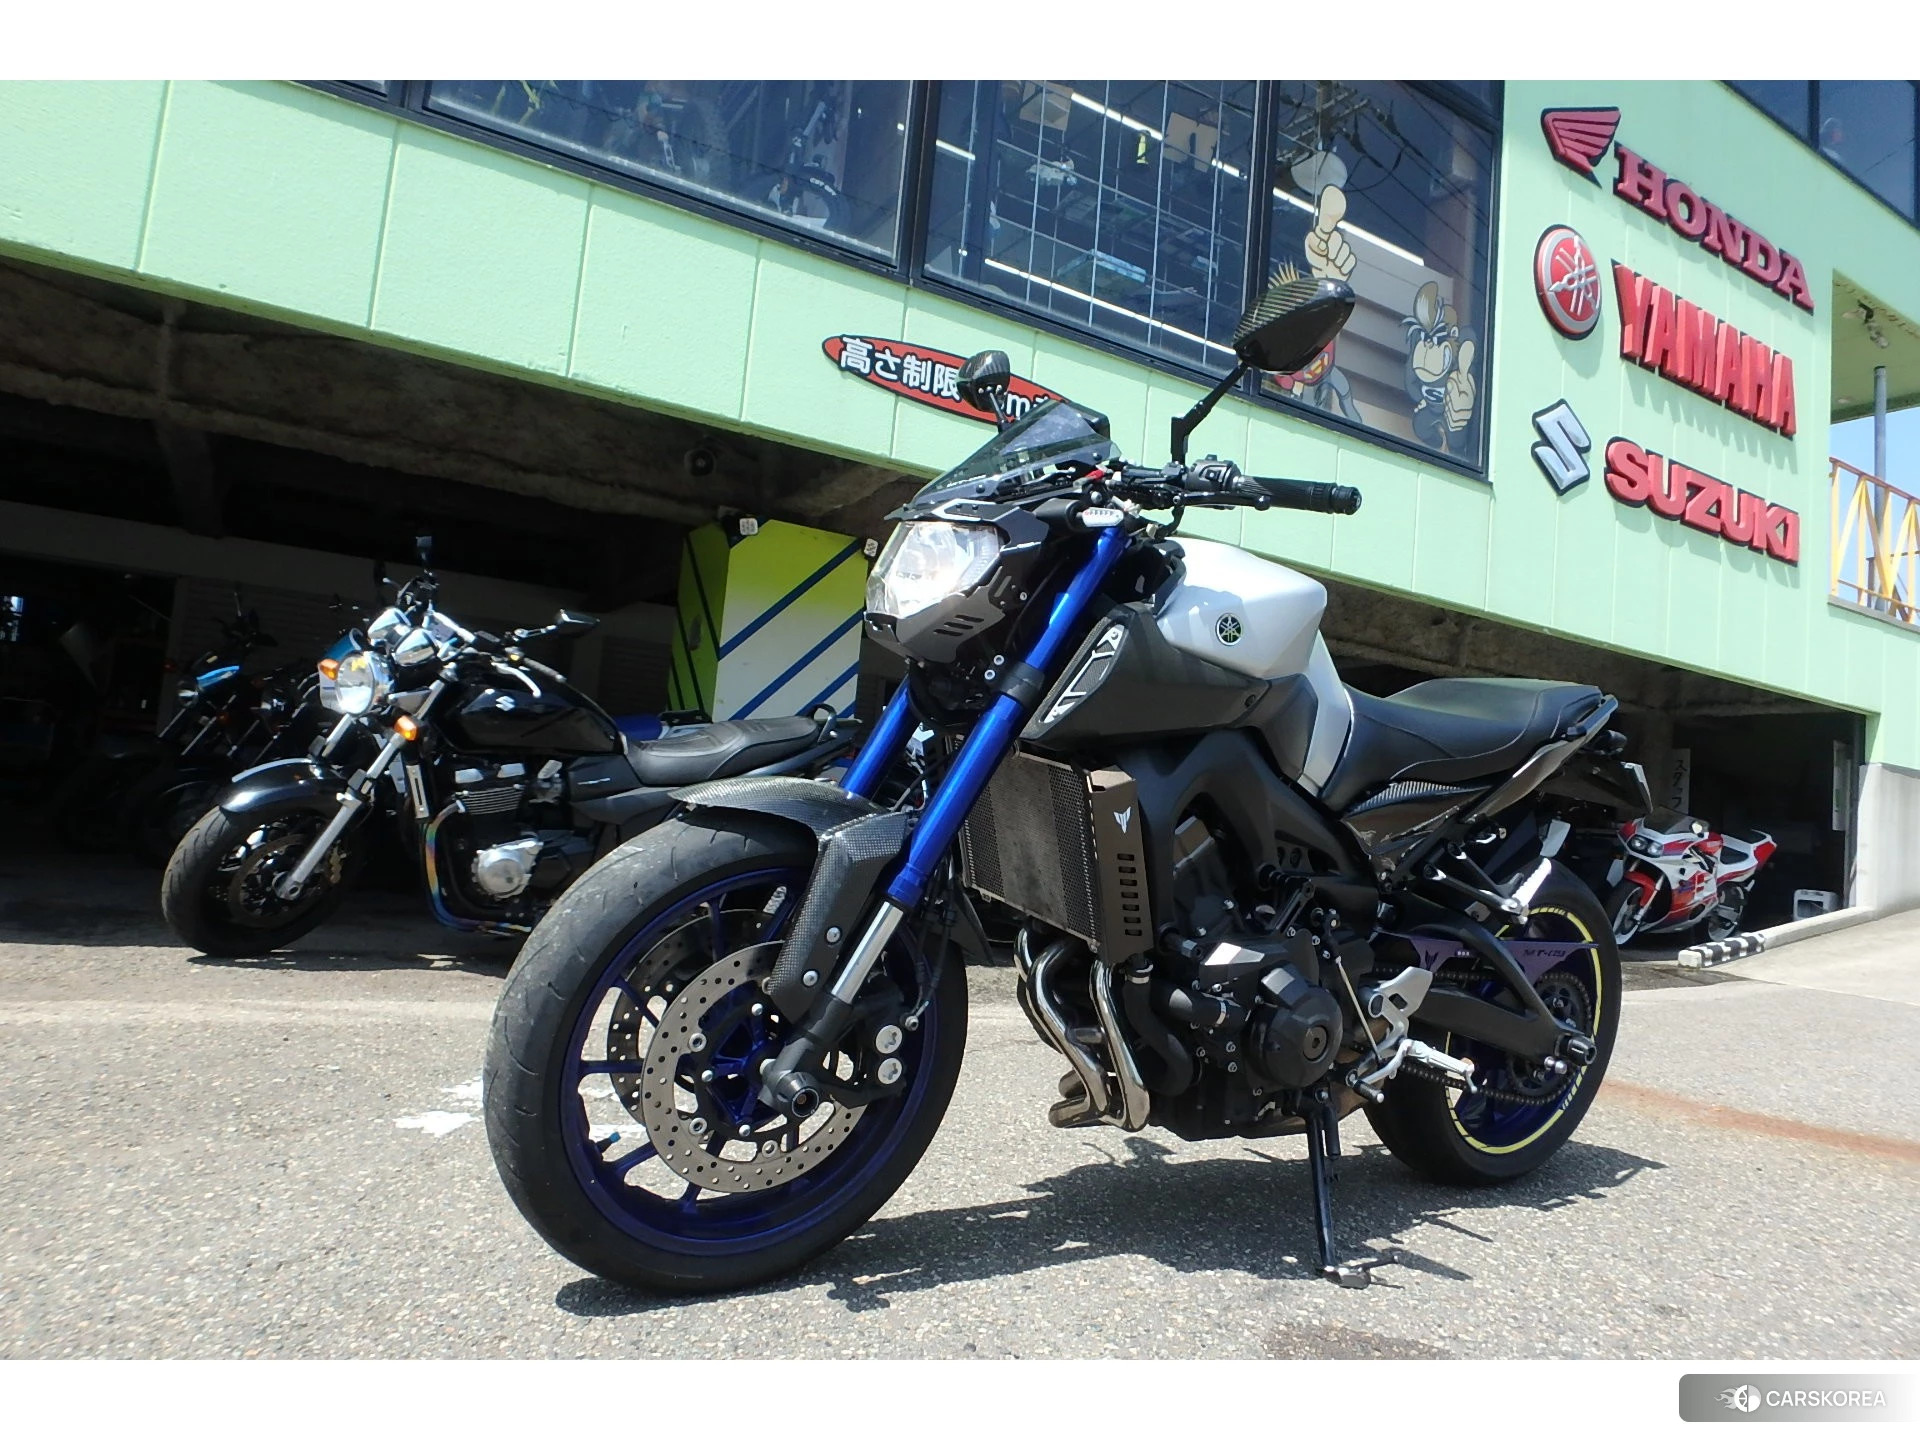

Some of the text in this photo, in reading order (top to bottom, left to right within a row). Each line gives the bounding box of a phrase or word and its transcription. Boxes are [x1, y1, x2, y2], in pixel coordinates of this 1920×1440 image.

[1614, 143, 1814, 314] HONDA
[1611, 260, 1796, 439] YAMAHA
[1604, 437, 1800, 565] SUZUKI
